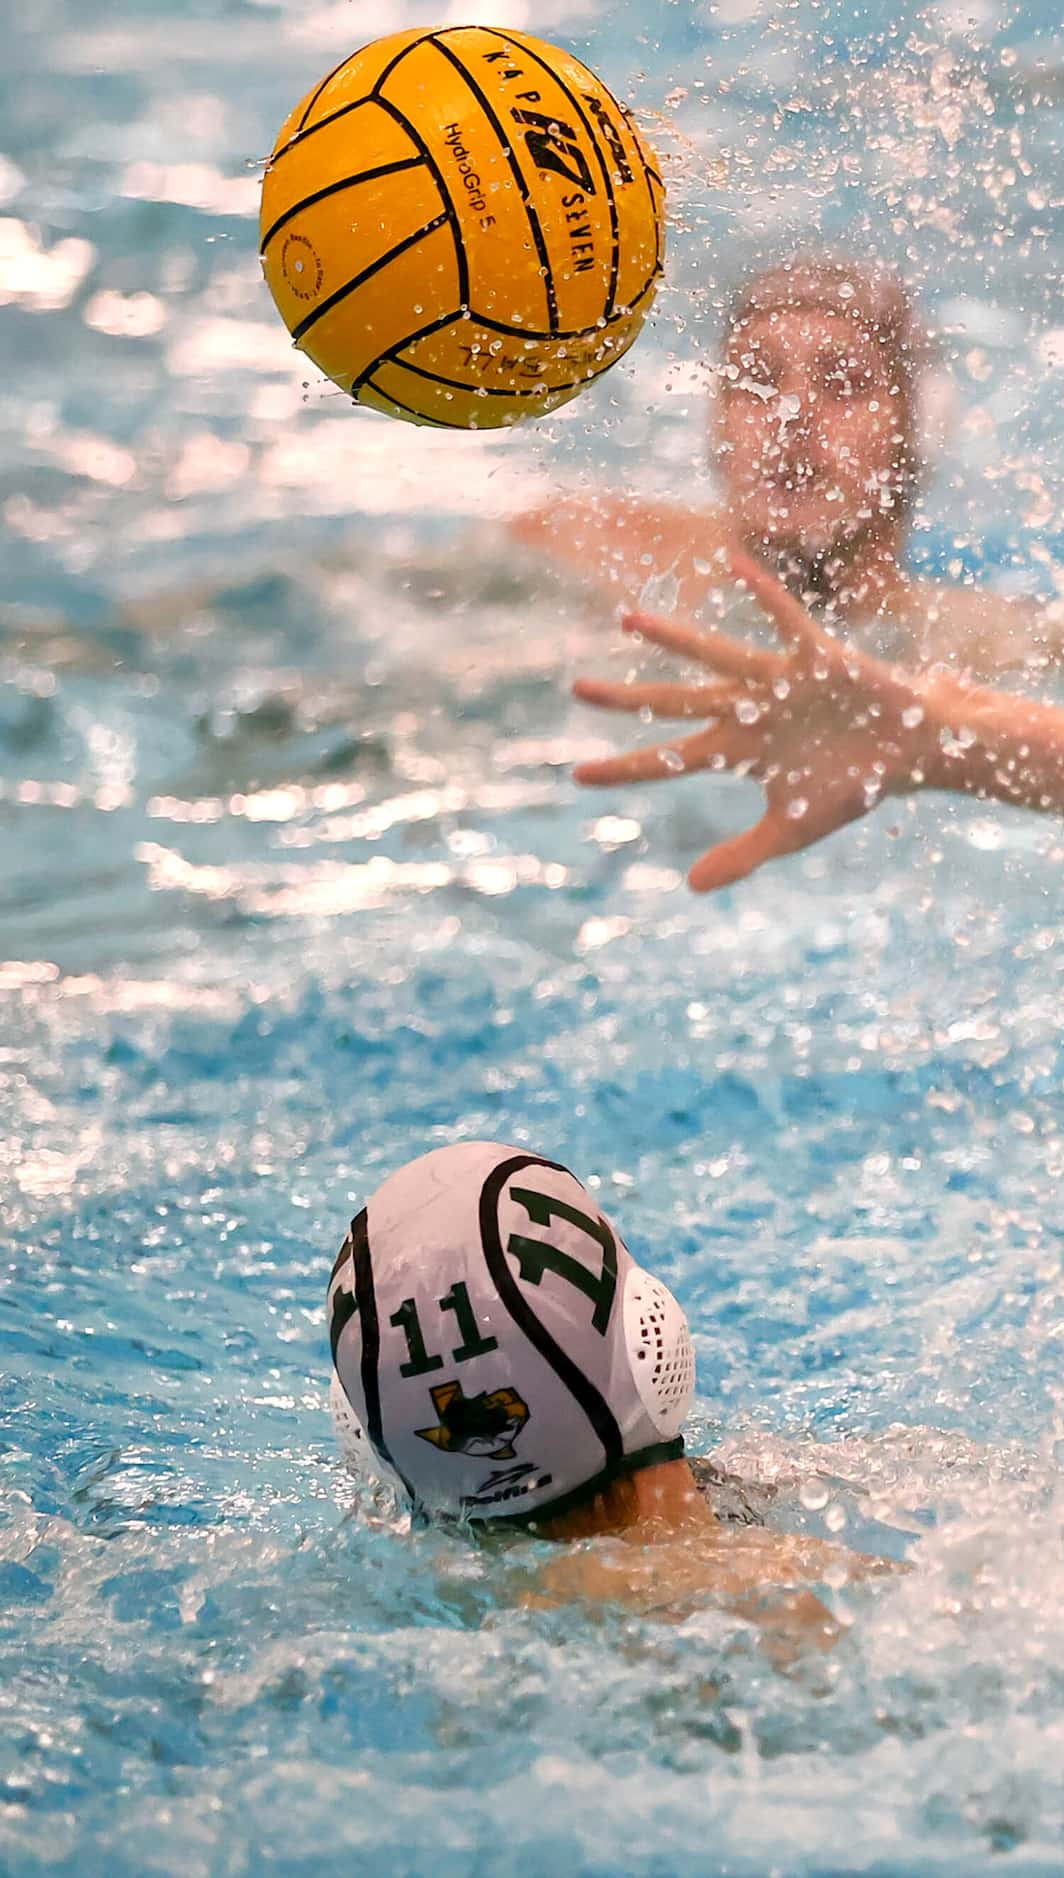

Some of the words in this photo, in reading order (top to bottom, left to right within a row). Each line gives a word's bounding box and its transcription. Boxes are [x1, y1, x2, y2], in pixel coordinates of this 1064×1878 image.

[482, 50, 542, 105] KAP
[444, 122, 487, 212] HydroGrip
[479, 215, 497, 229] 5
[560, 193, 595, 273] SEVEN
[506, 1186, 618, 1337] 11
[389, 1281, 499, 1378] 11
